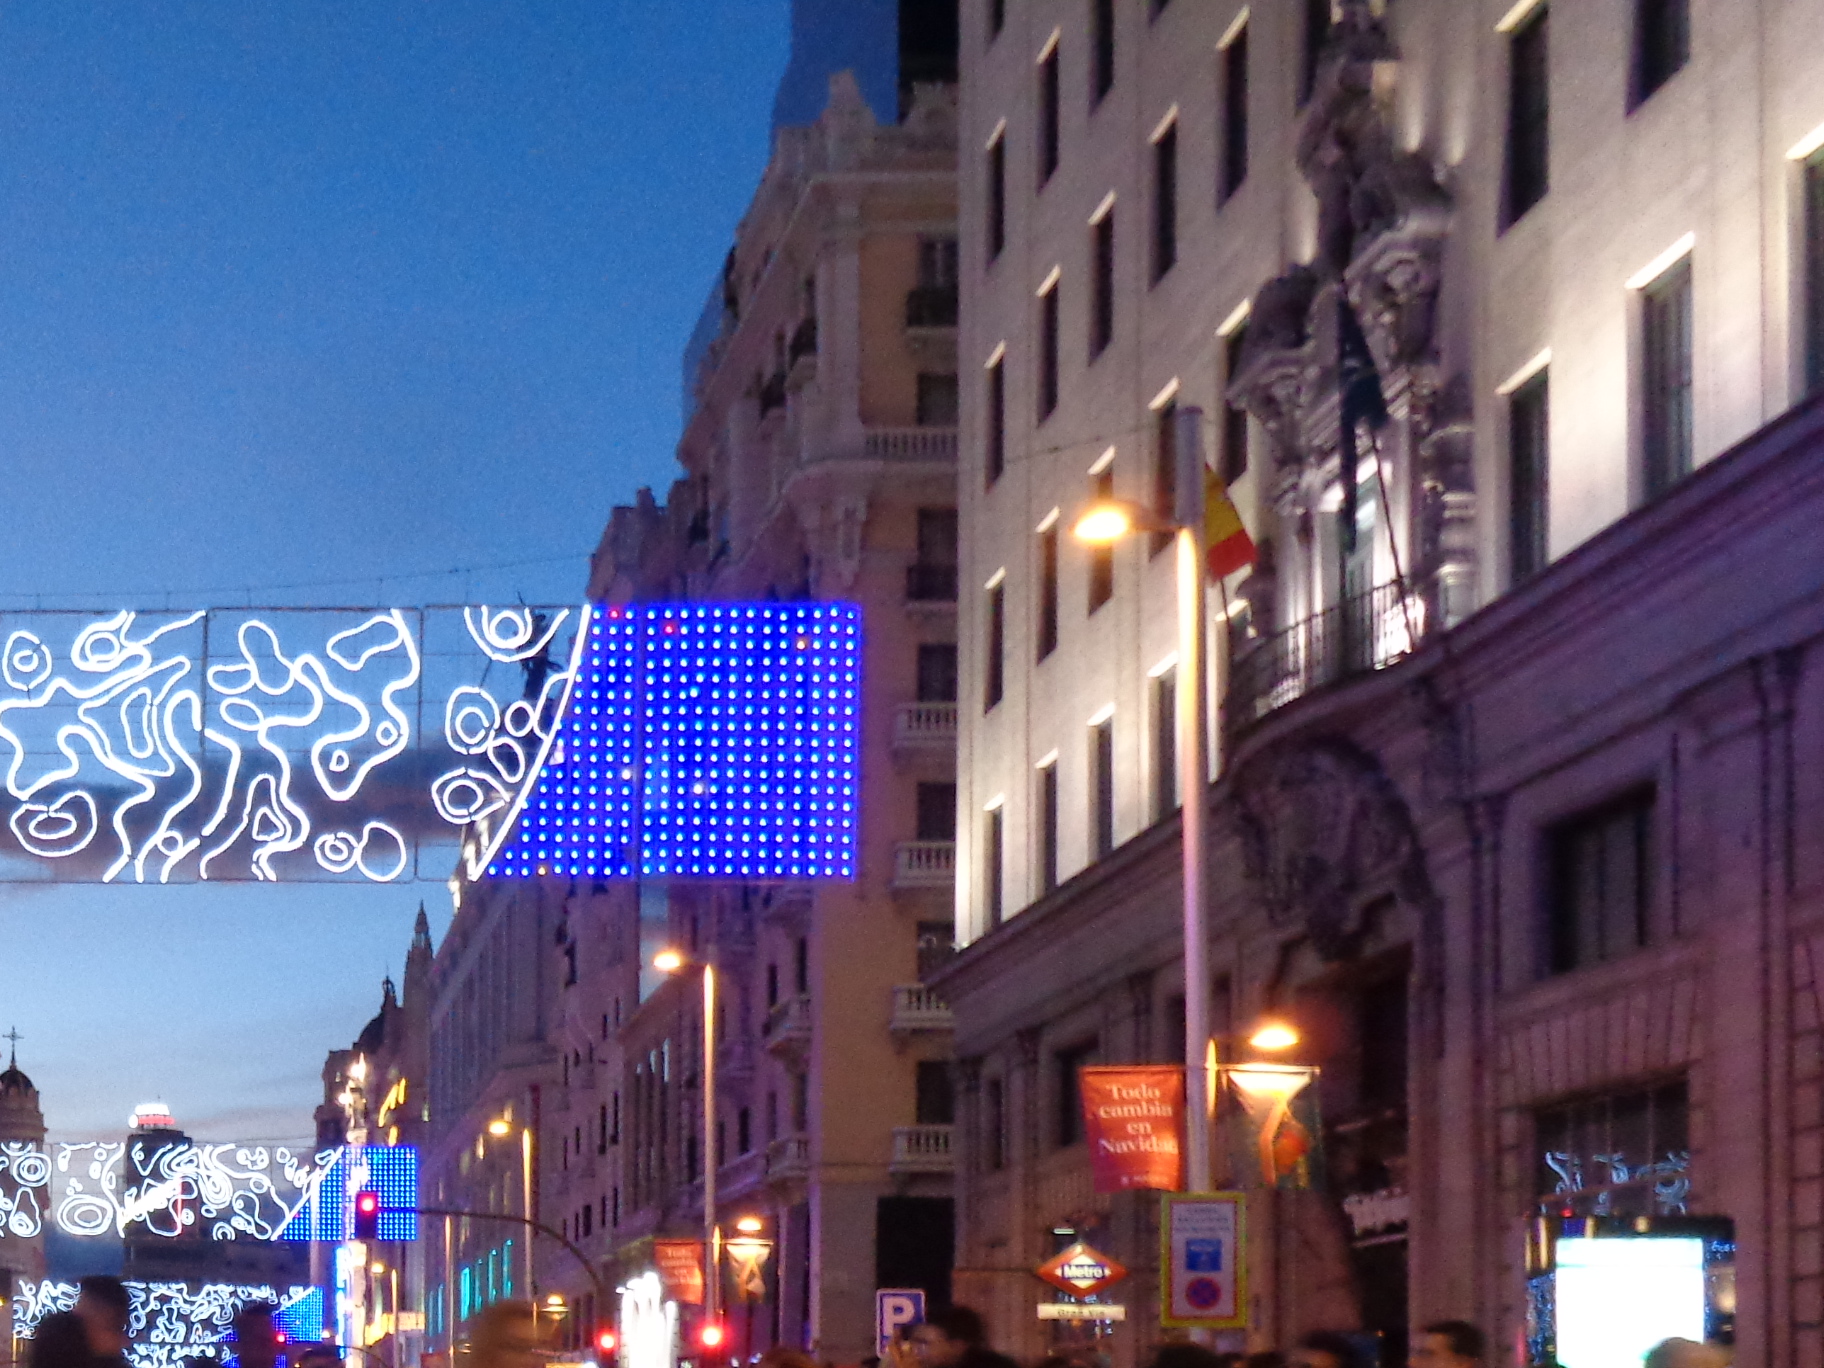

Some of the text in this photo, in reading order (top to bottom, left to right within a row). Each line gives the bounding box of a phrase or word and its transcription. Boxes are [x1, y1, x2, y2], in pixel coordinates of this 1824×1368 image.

[1106, 1083, 1161, 1100] Todo
[1099, 1101, 1173, 1118] cambia
[1126, 1121, 1153, 1135] en
[1063, 1264, 1104, 1278] Metro
[882, 1297, 916, 1336] P
